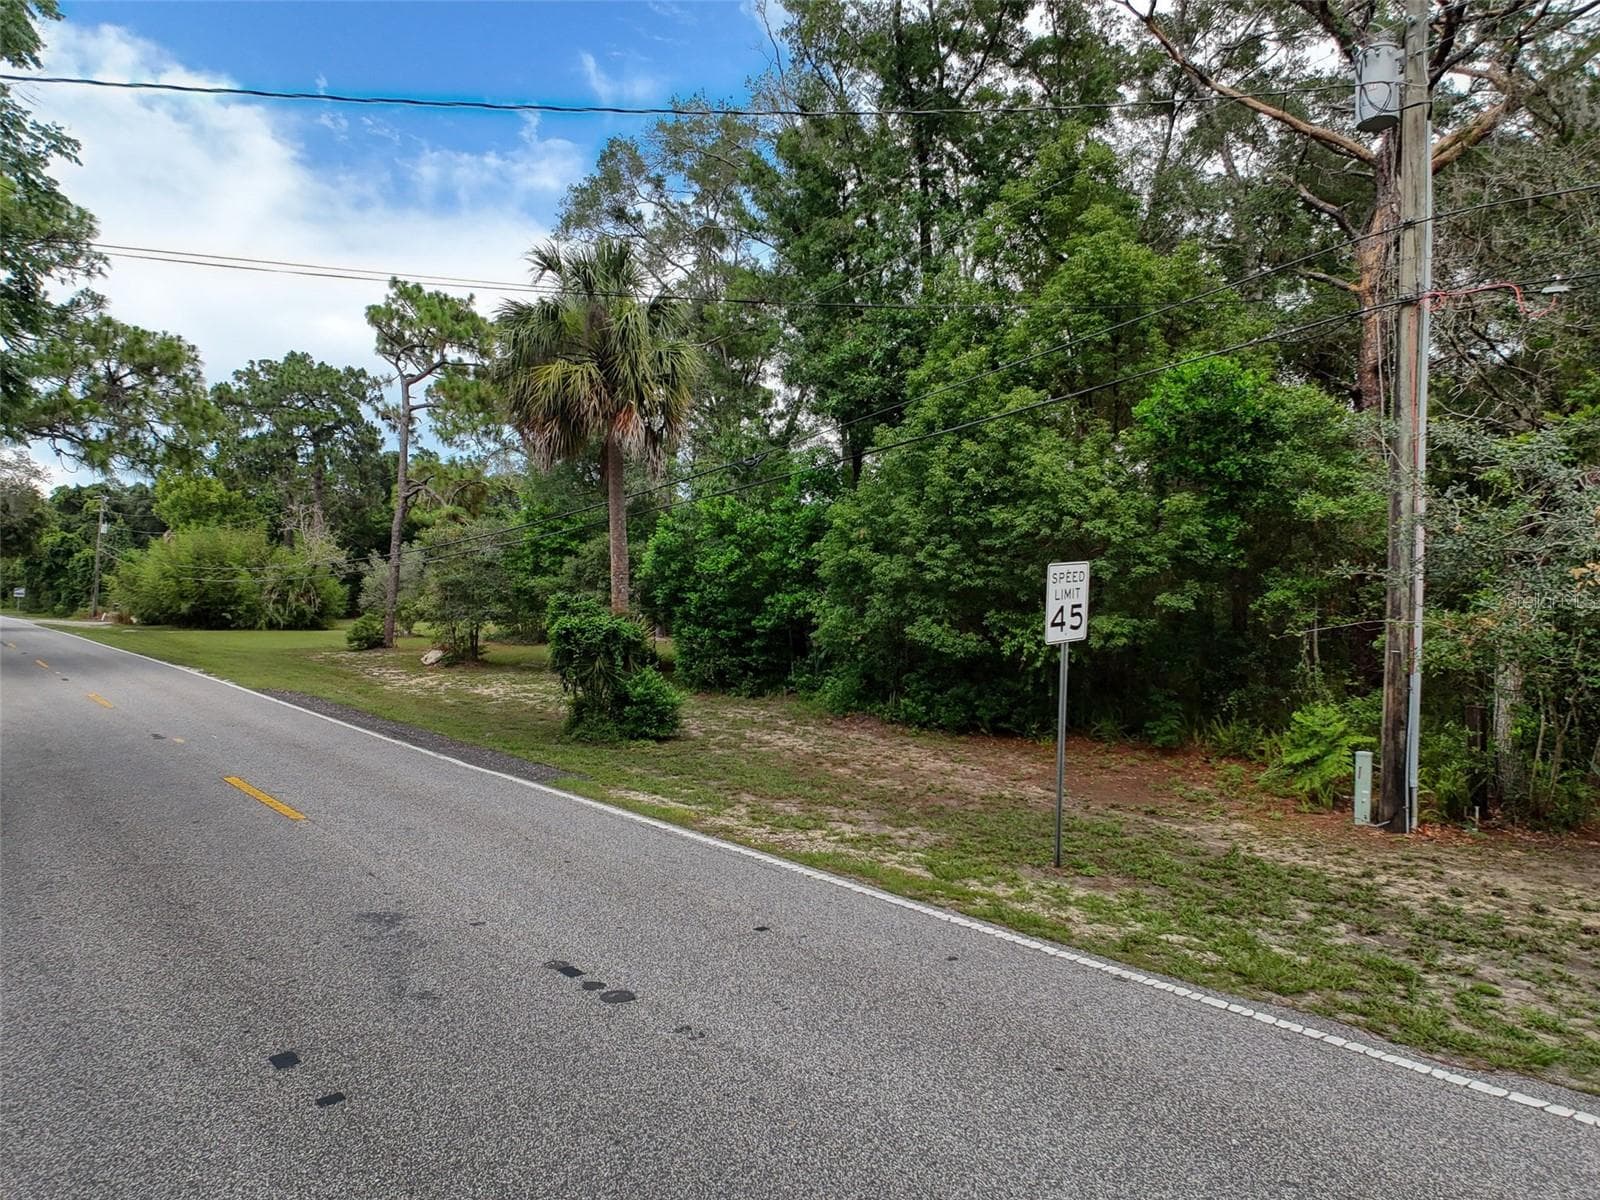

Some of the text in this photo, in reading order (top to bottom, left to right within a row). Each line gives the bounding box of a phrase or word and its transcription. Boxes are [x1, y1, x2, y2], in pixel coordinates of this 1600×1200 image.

[1052, 571, 1085, 584] SPEED
[1055, 588, 1080, 600] LIMIT
[1050, 603, 1083, 633] 45
